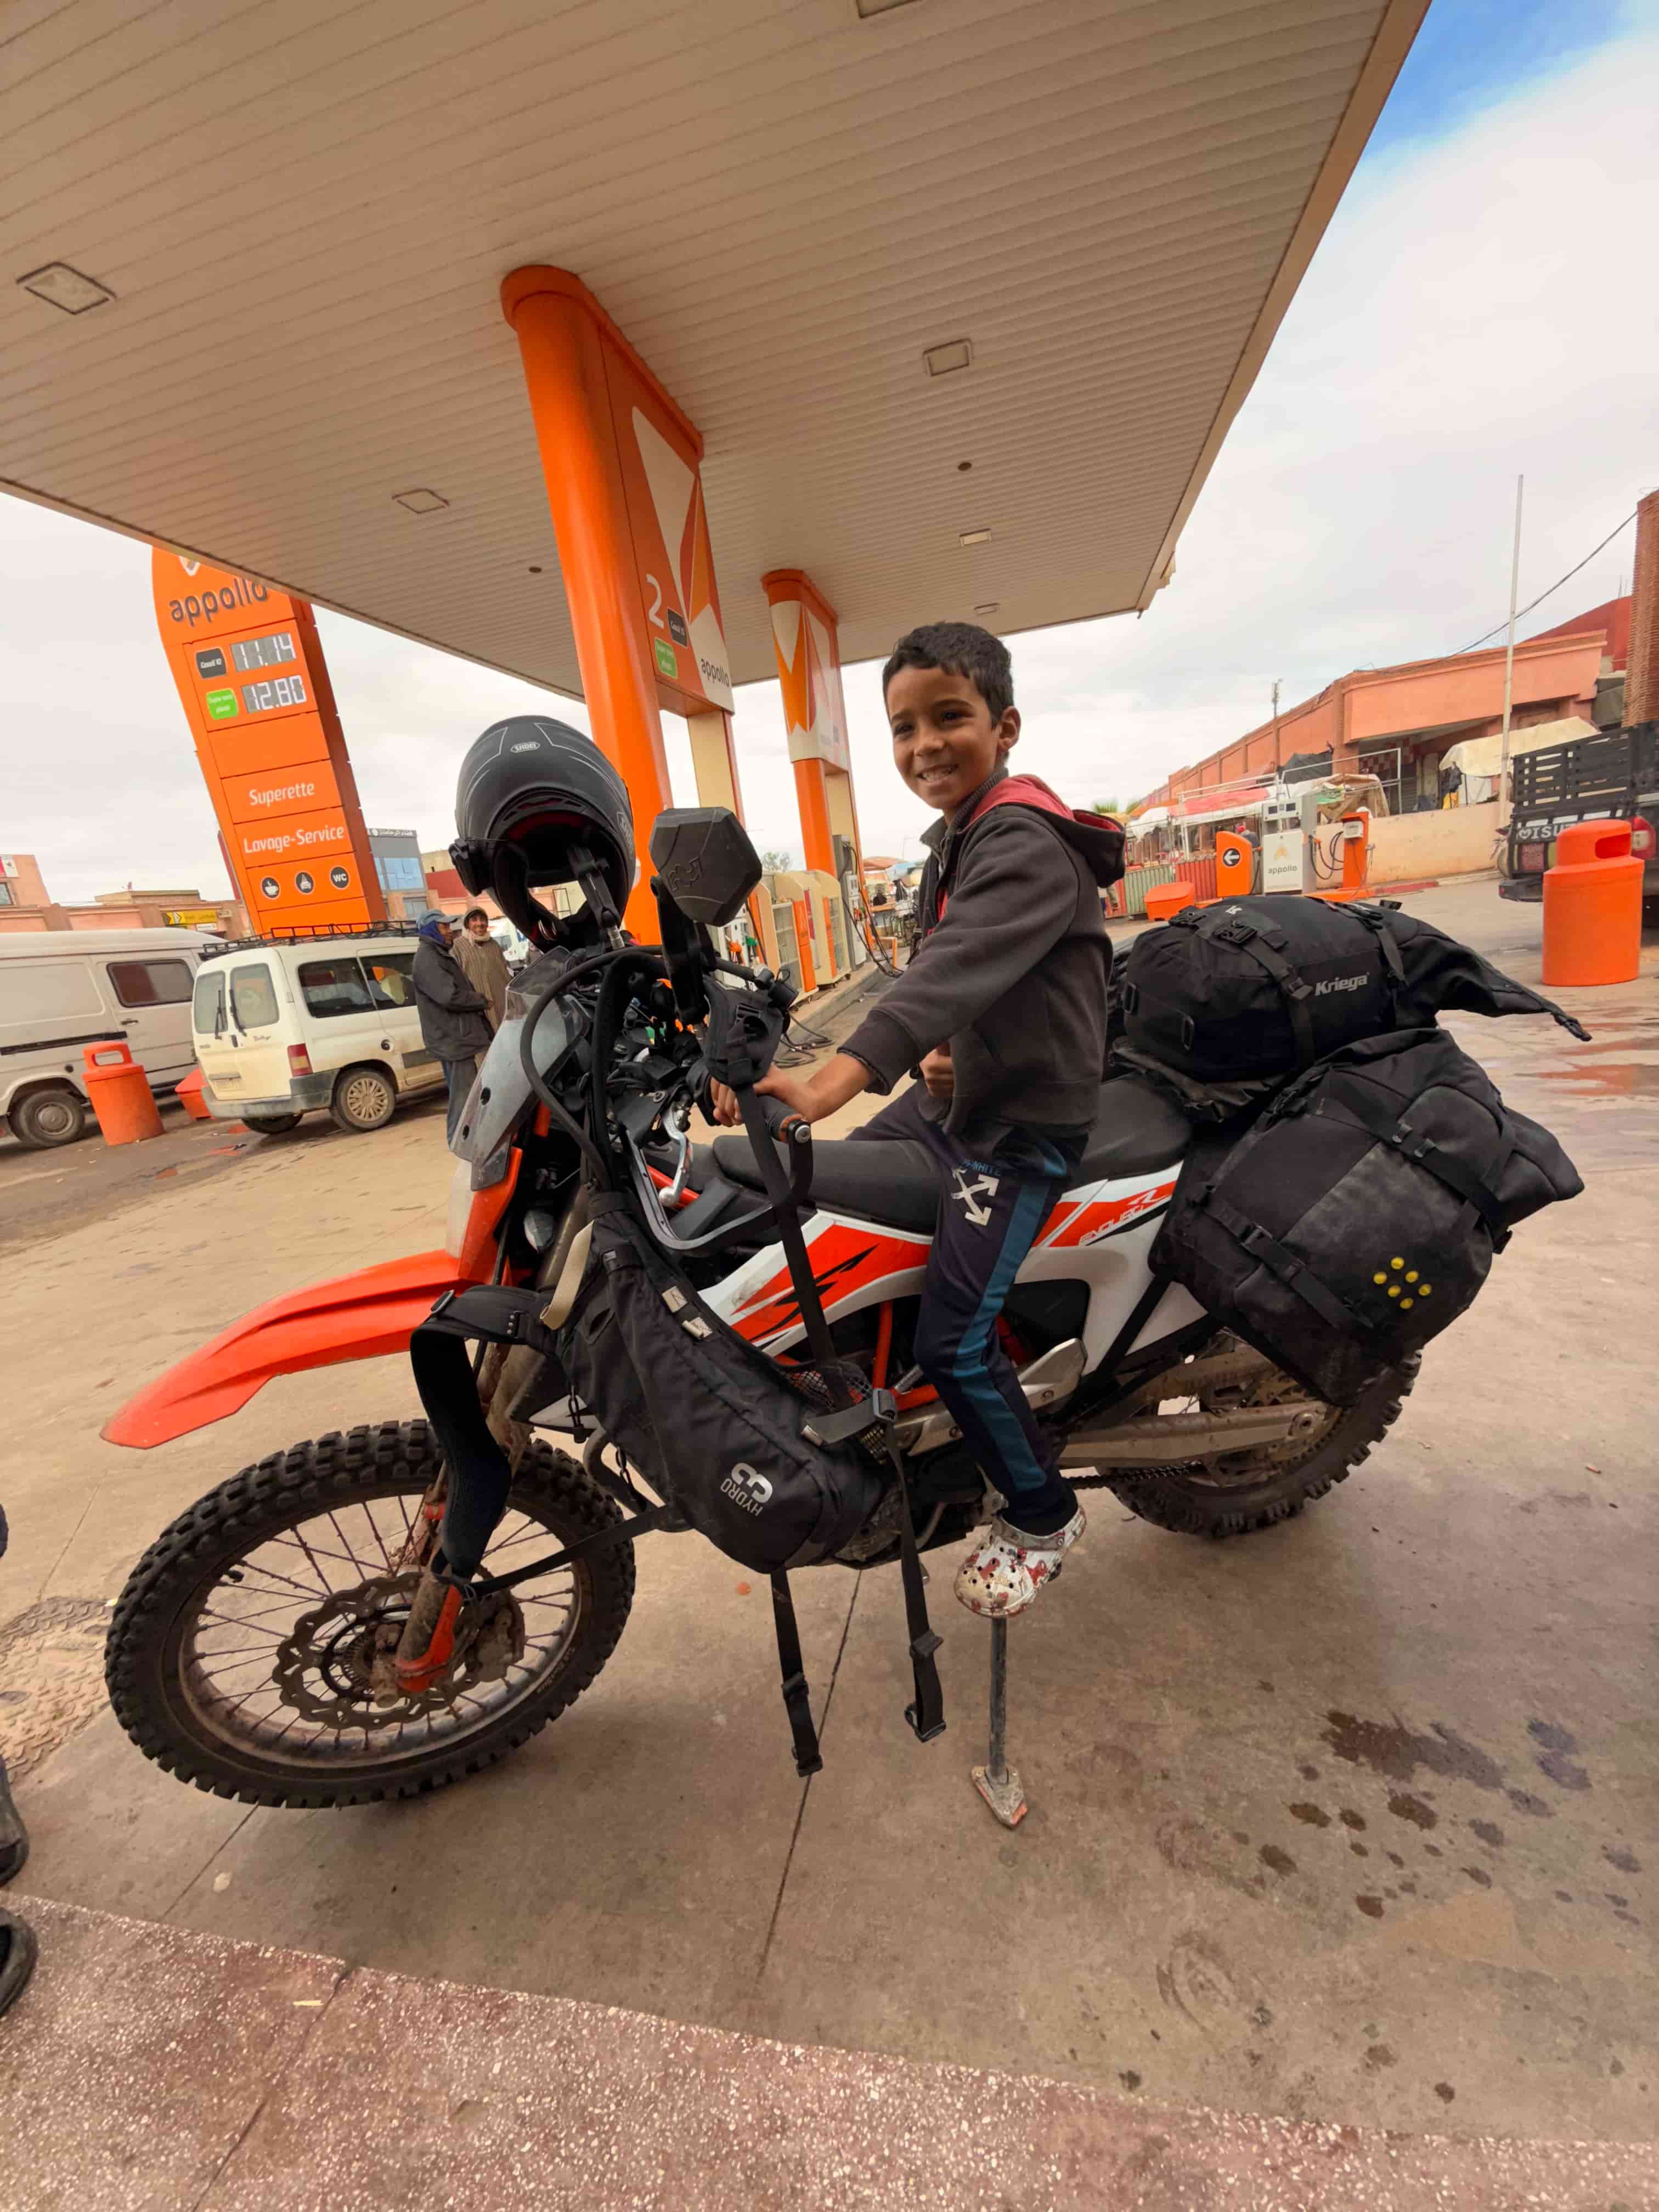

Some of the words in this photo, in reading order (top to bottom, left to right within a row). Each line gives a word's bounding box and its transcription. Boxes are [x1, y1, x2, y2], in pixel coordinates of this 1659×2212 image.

[169, 578, 268, 628] appollo
[646, 573, 664, 629] 2
[240, 633, 297, 669] 11.14
[701, 658, 730, 687] appollo
[251, 675, 307, 710] 12.80
[249, 783, 315, 807] Superette
[244, 826, 345, 854] Lavage-Service
[1531, 824, 1576, 839] ISU
[332, 873, 347, 883] WC
[1268, 865, 1297, 875] appollo
[1315, 974, 1368, 997] Kriega
[720, 1477, 764, 1516] HYDRO
